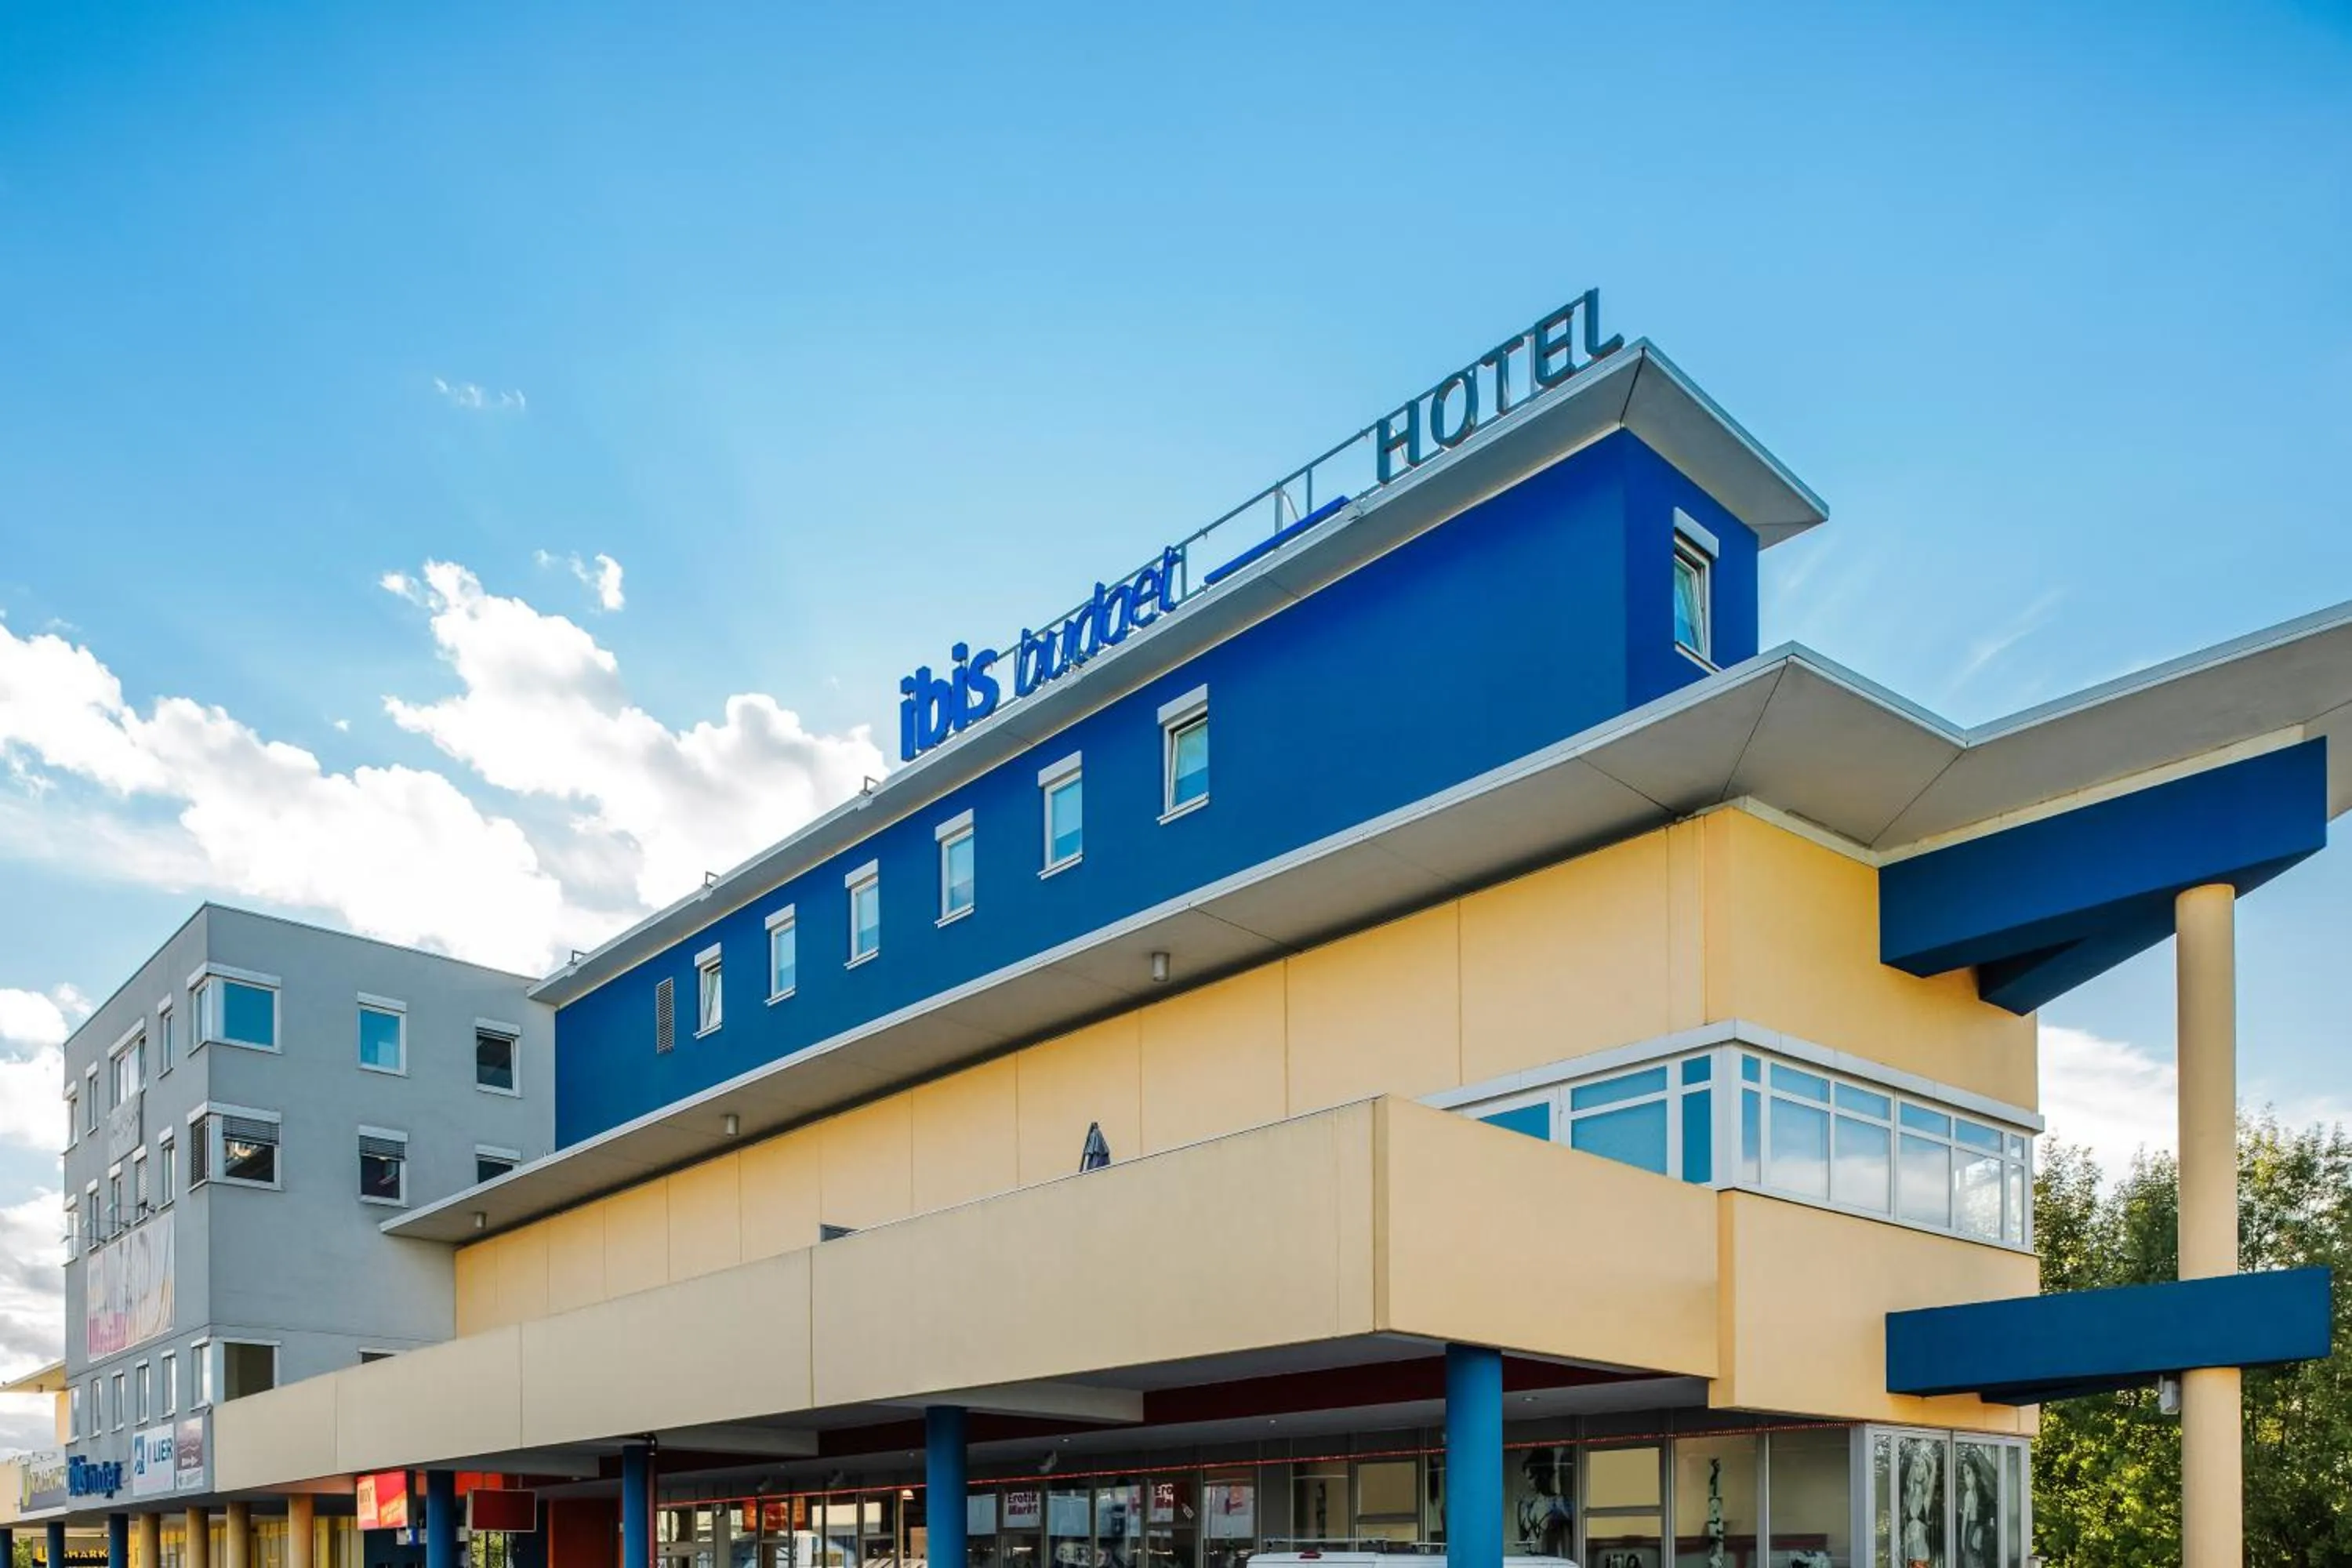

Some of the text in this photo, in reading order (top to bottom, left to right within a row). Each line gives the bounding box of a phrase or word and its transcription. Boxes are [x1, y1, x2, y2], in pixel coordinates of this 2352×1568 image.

[1377, 288, 1625, 485] HOTEL
[900, 546, 1184, 761] ibis budget
